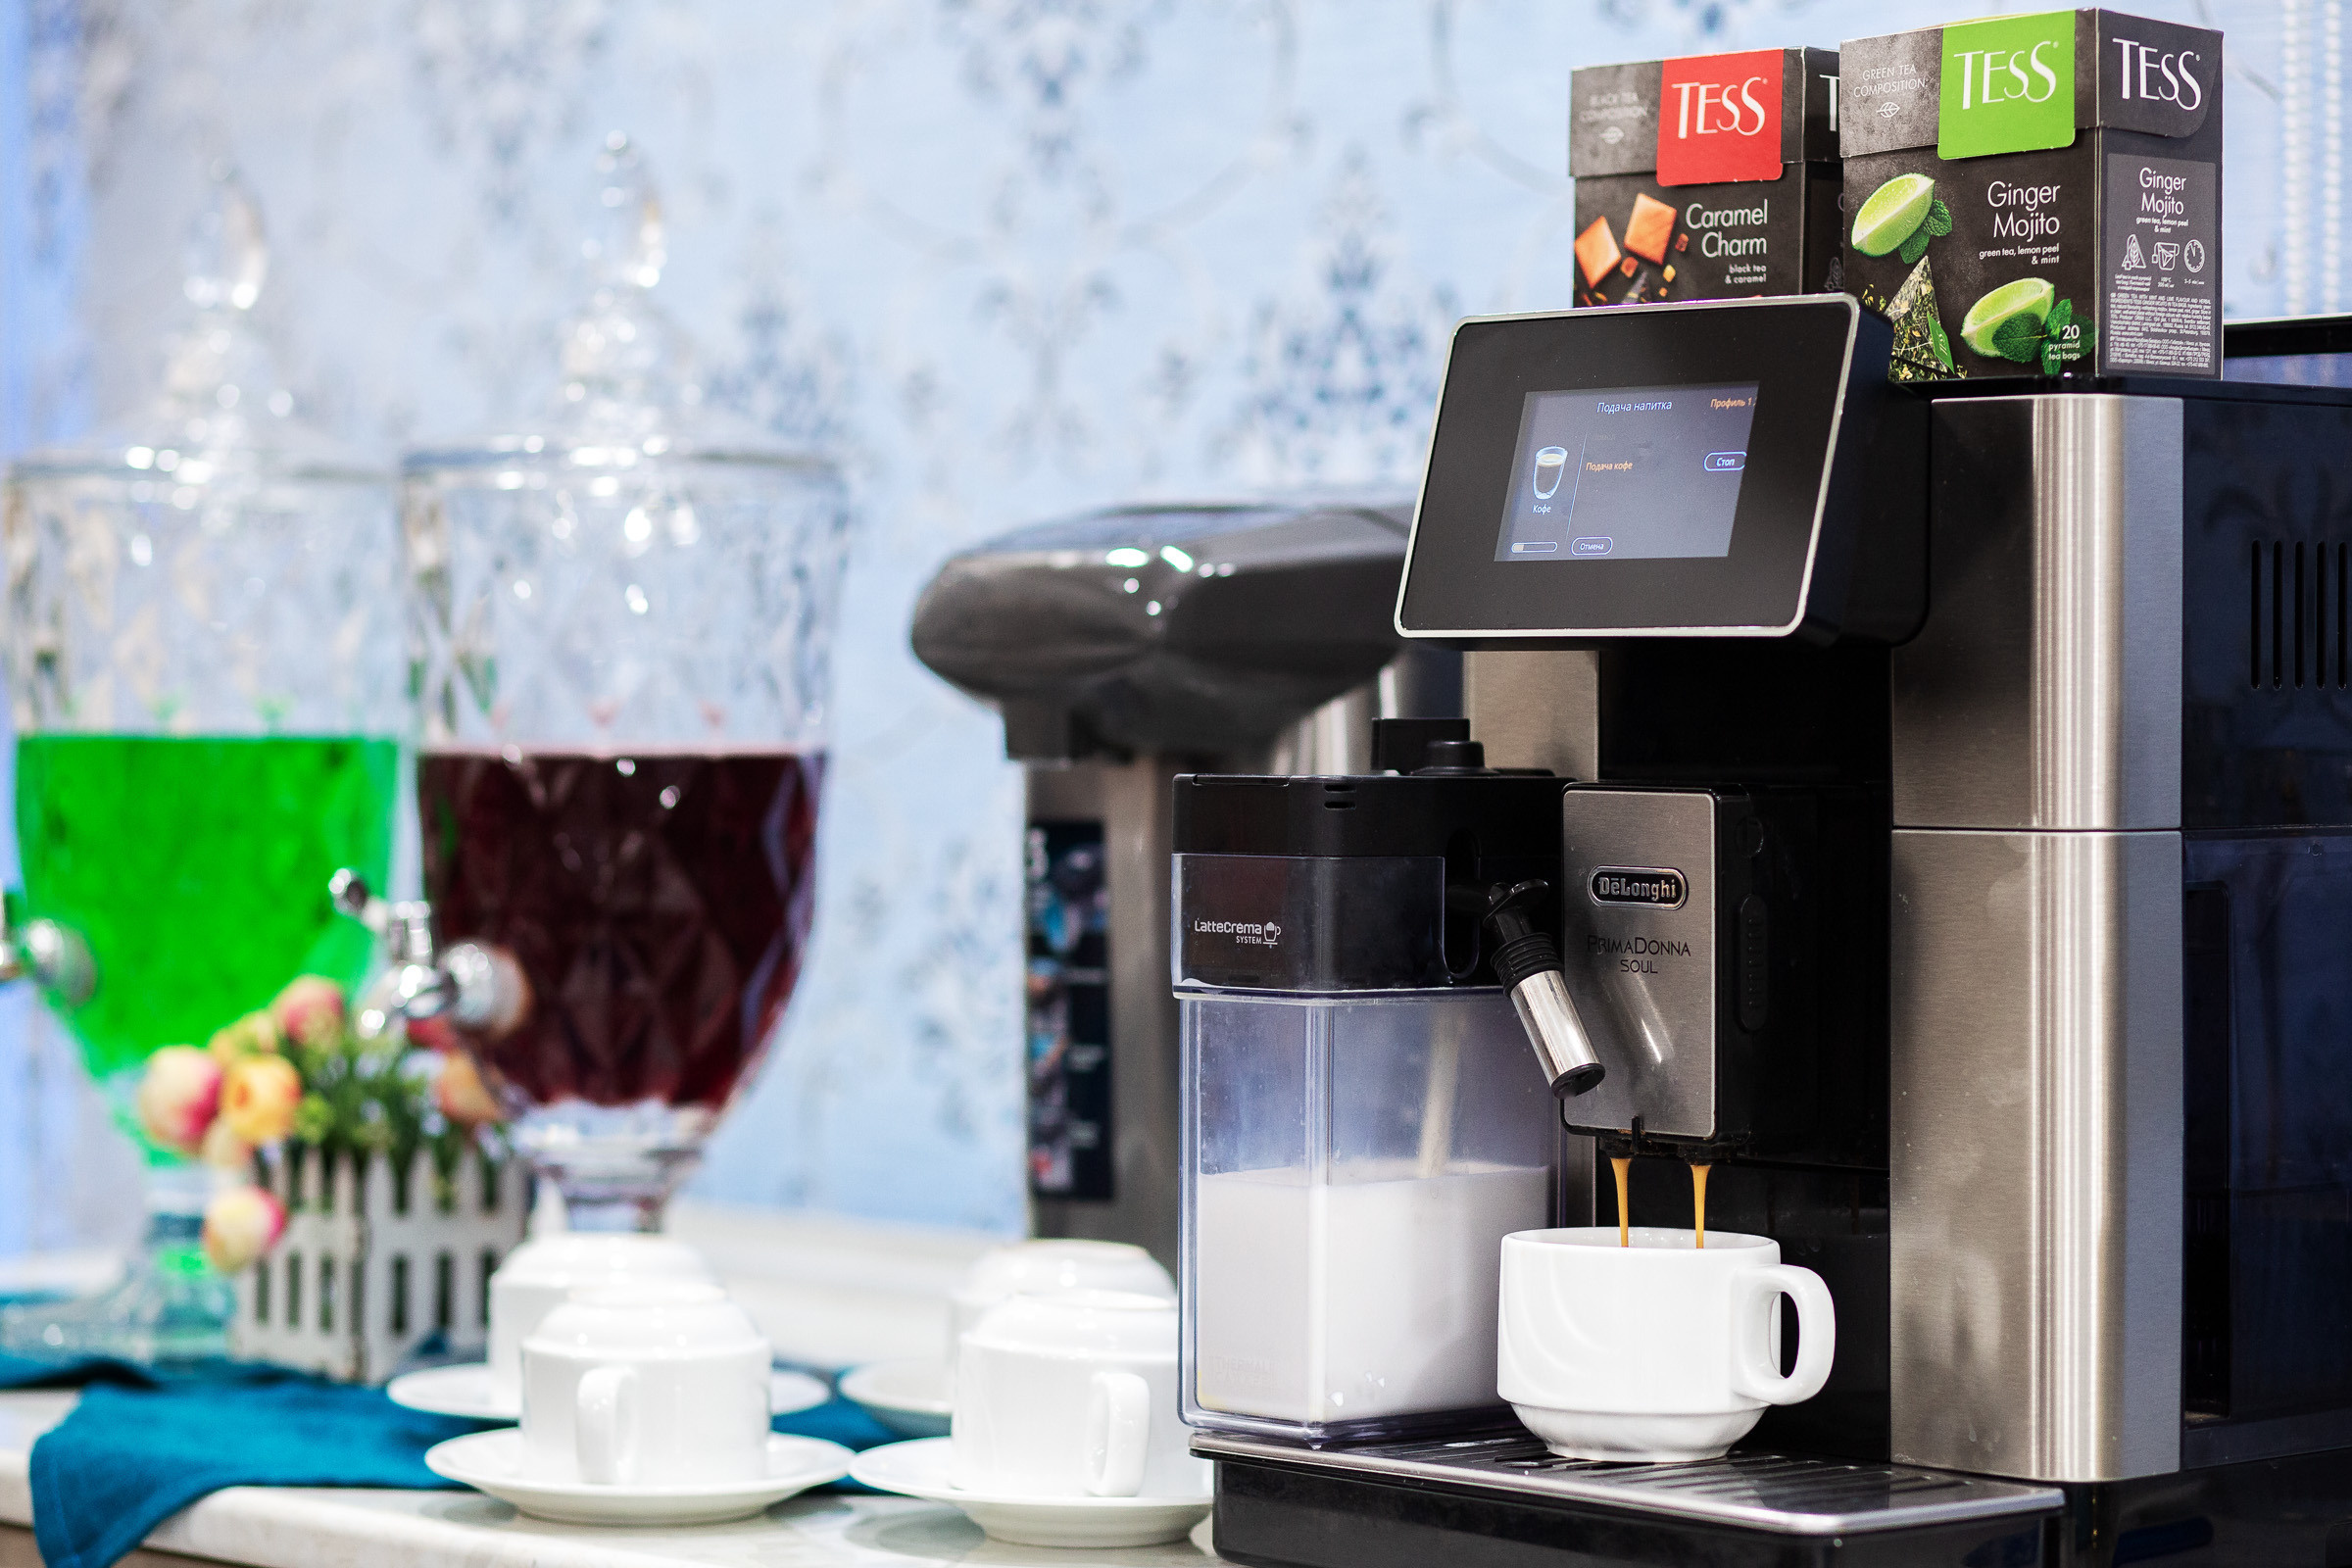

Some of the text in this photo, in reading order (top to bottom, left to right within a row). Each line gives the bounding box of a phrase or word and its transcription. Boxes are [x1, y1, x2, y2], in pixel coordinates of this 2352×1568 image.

[1863, 64, 1917, 81] GREEN TEA
[1953, 40, 2057, 110] TESS
[2112, 37, 2201, 111] TESS
[1853, 78, 1926, 98] COMPOSITION
[1671, 76, 1766, 139] TESS
[2139, 167, 2186, 195] Ginger
[1987, 180, 2061, 212] Ginger
[2141, 192, 2183, 218] Mojito
[1686, 198, 1768, 229] Caramel
[1993, 212, 2060, 243] Mojito
[1701, 231, 1766, 258] Charm
[1979, 243, 2059, 260] green tea, lemon peel
[2032, 254, 2060, 265] & mint
[1729, 264, 1766, 273] black tea
[1725, 272, 1766, 284] & caramel
[2062, 324, 2081, 340] 20
[2048, 340, 2081, 352] pyramid
[2062, 352, 2081, 362] bags
[1596, 400, 1673, 415] Подача напитка
[1710, 397, 1746, 410] Профиль
[1586, 461, 1634, 472] Подача кофе
[1716, 457, 1736, 467] Стоп
[1533, 504, 1552, 514] Кофе
[1580, 542, 1604, 551] Отмена
[1236, 935, 1262, 945] SYSTEM
[1620, 959, 1658, 974] SOUL
